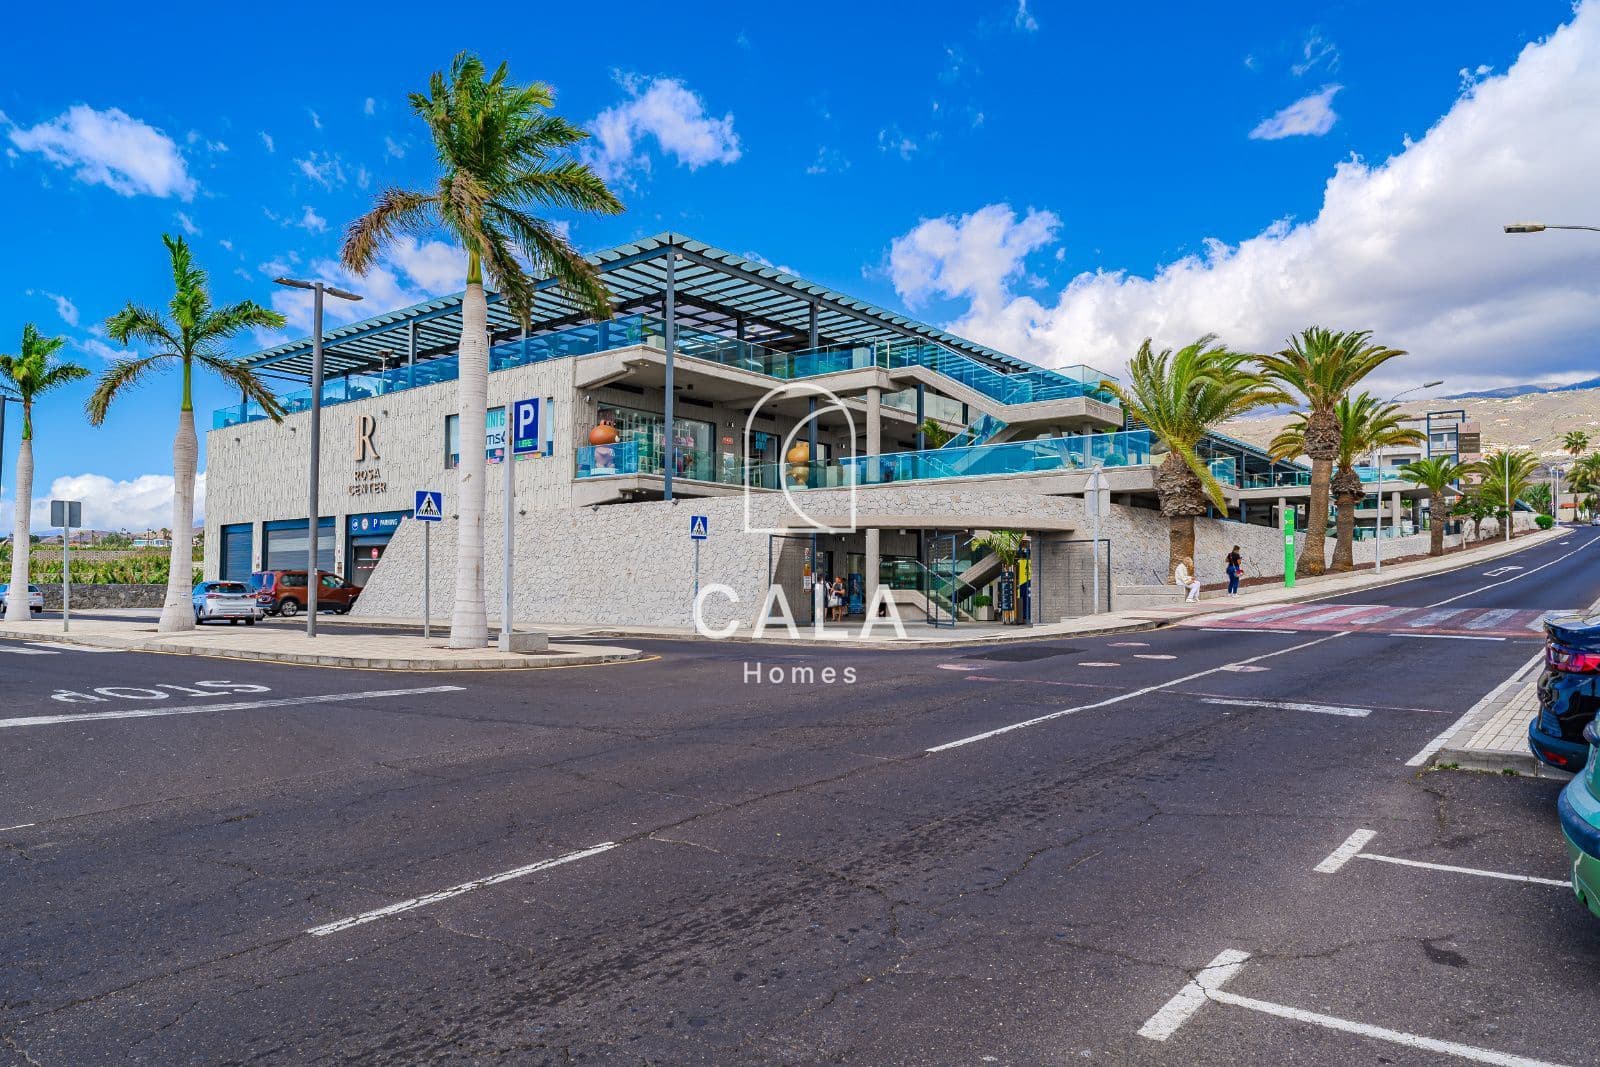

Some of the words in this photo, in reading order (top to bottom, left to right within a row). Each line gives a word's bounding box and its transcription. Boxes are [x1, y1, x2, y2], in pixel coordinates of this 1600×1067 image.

[519, 404, 534, 438] P
[353, 414, 380, 461] R
[354, 468, 381, 481] ROSA
[348, 482, 387, 496] CENTER
[51, 680, 272, 703] STOP
